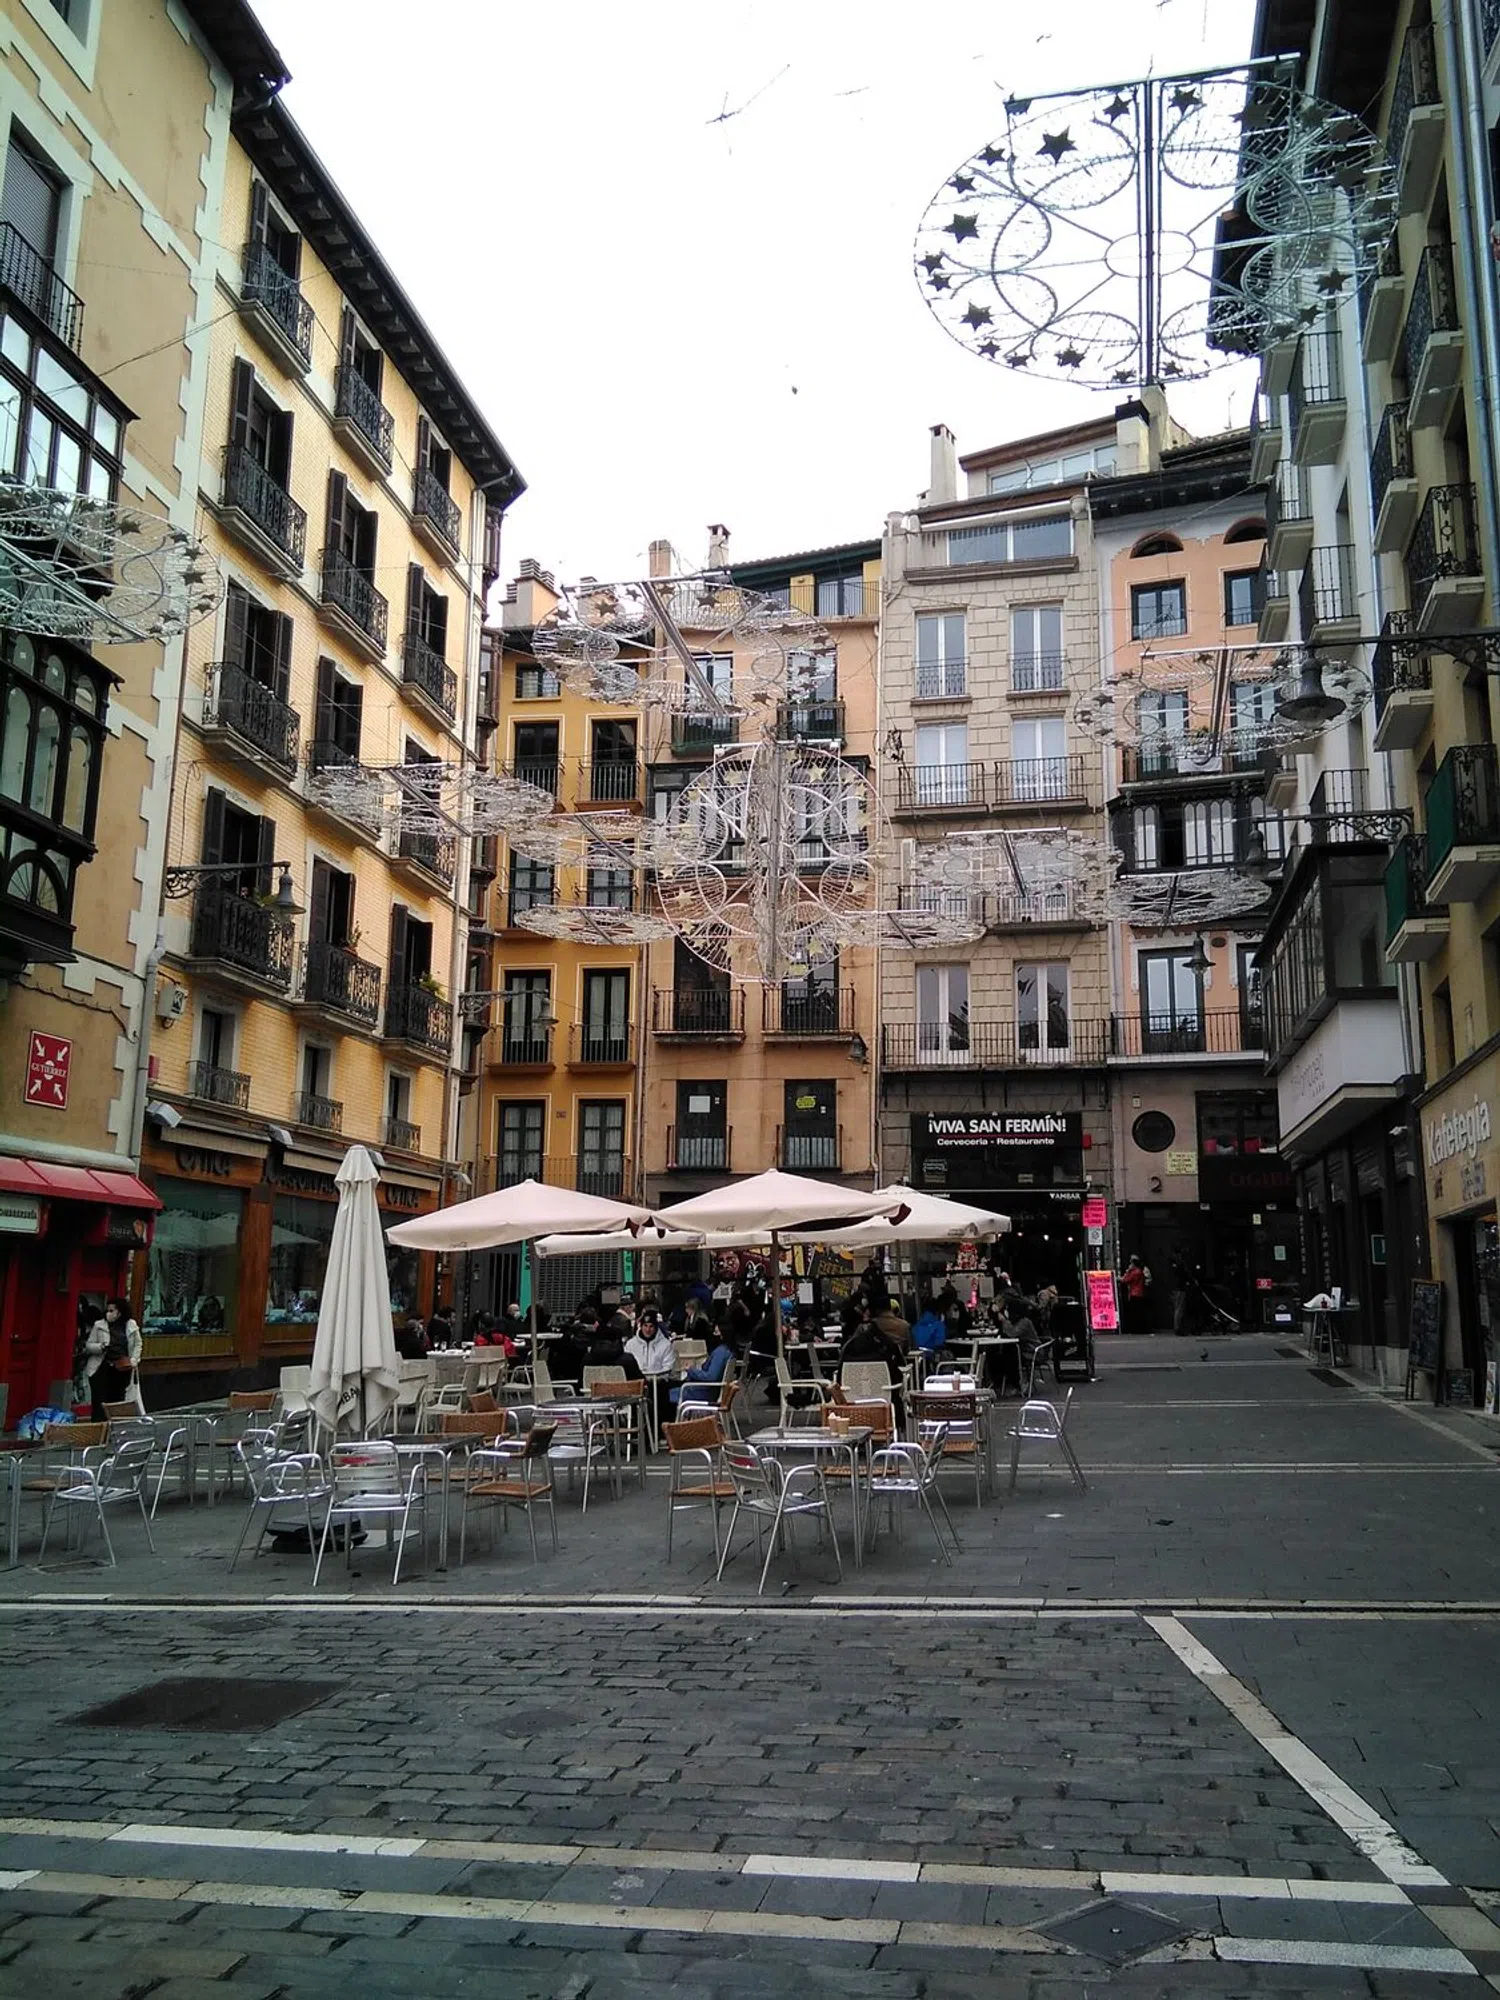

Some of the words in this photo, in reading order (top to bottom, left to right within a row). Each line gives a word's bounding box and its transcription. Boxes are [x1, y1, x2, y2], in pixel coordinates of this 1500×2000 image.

[929, 1119, 966, 1133] ¡VIVA
[969, 1118, 1002, 1133] SAN
[1005, 1114, 1067, 1133] FERMÍN!
[1426, 1093, 1492, 1168] Kafetegia
[996, 1137, 1055, 1146] Restaurante
[1151, 1177, 1163, 1193] 2
